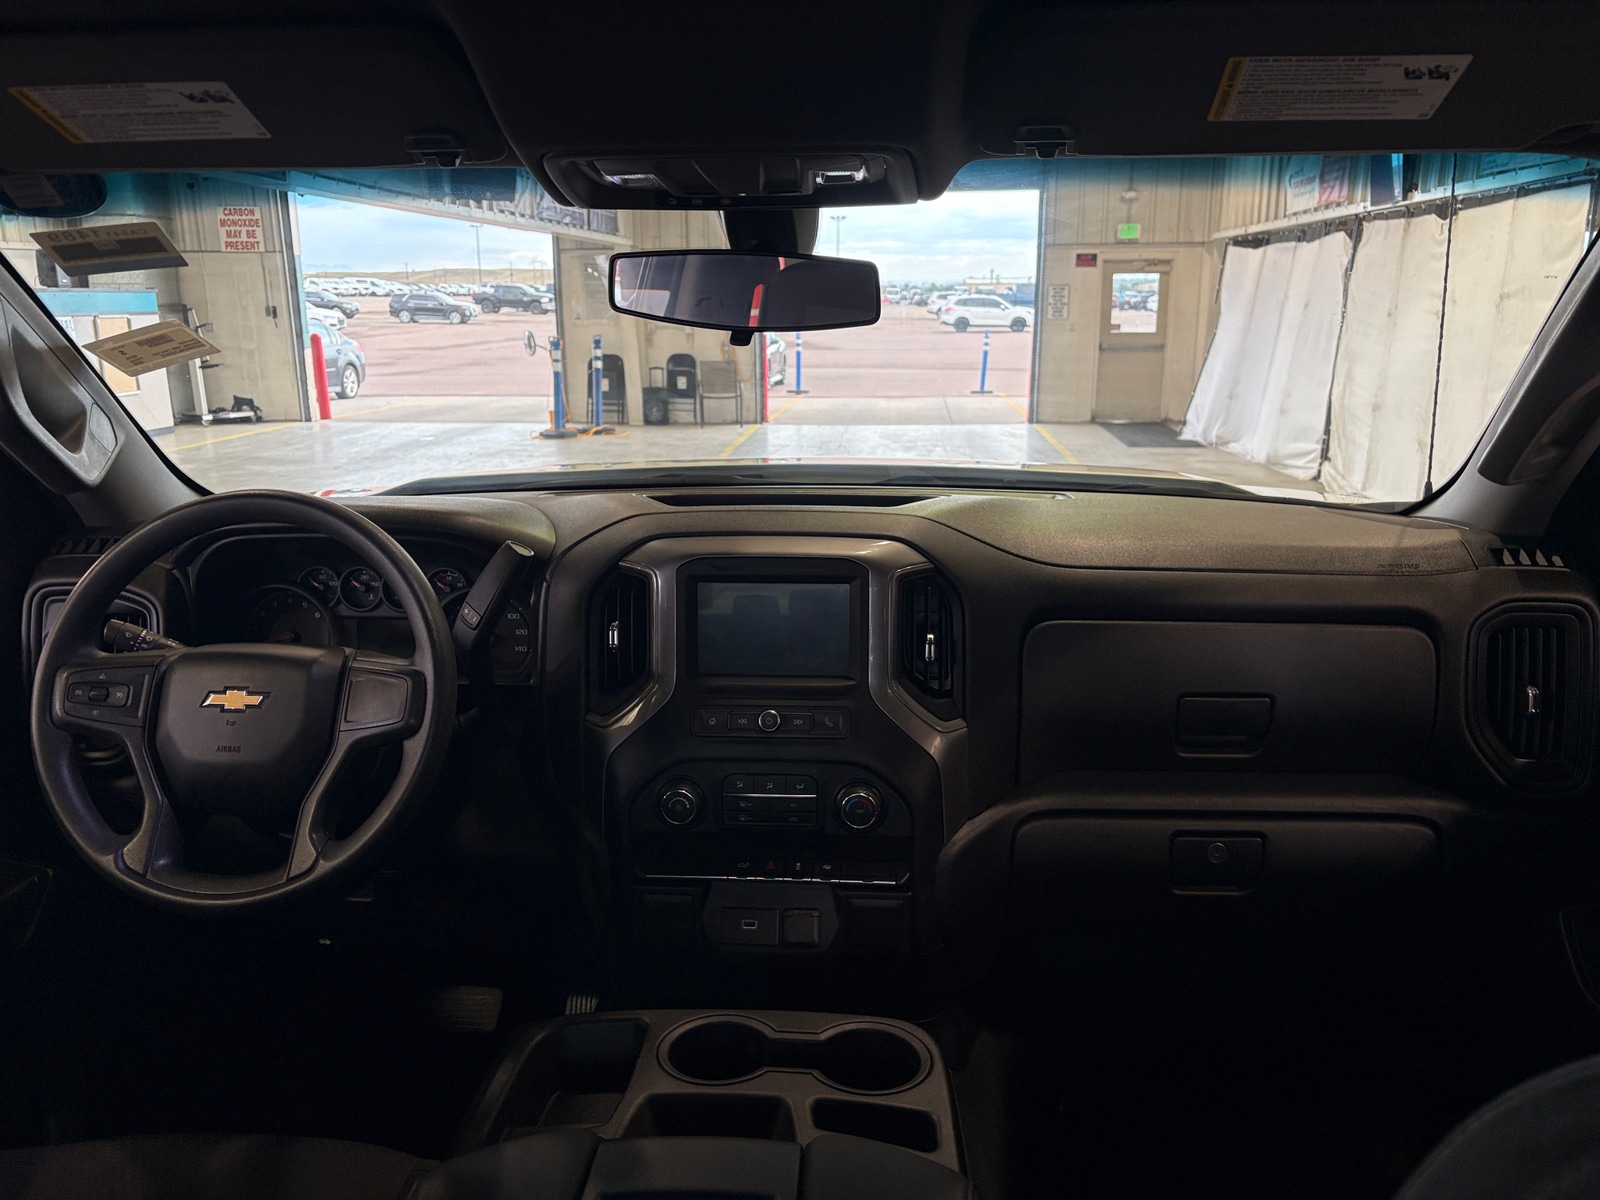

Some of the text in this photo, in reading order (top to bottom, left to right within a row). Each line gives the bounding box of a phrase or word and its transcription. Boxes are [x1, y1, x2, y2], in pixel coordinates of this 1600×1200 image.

[223, 207, 255, 217] CARBON
[219, 218, 261, 228] MONOXIDE
[226, 229, 257, 239] MAY BE
[225, 240, 260, 251] PRESENT
[315, 611, 321, 619] 6
[507, 612, 520, 620] 100
[515, 628, 528, 636] 120
[216, 744, 242, 753] AIRBAG
